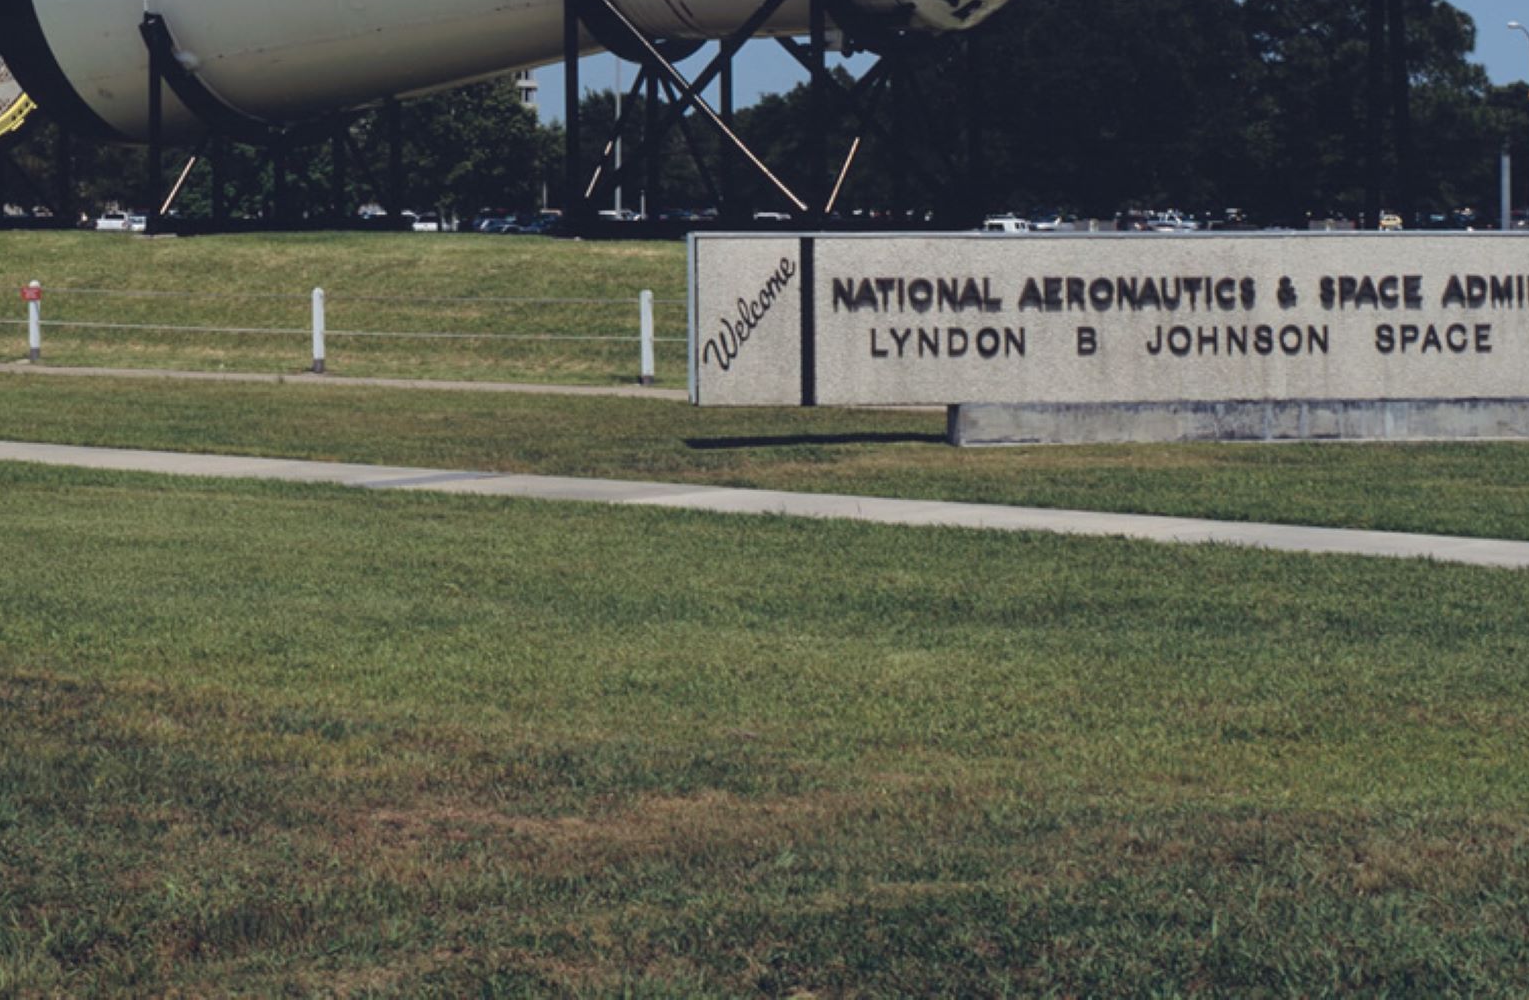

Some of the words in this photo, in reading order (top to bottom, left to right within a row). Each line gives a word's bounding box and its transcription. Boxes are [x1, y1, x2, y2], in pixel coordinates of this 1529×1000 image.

[832, 277, 1002, 312] NATIONAL
[1018, 276, 1255, 312] AERONAUTICS
[1276, 275, 1298, 311] &
[1319, 275, 1423, 311] SPACE
[703, 256, 796, 371] Welcome
[870, 326, 1027, 359] LYNDON
[1077, 326, 1097, 355] B
[1146, 324, 1329, 355] JOHNSON
[1375, 323, 1492, 354] SPACE
